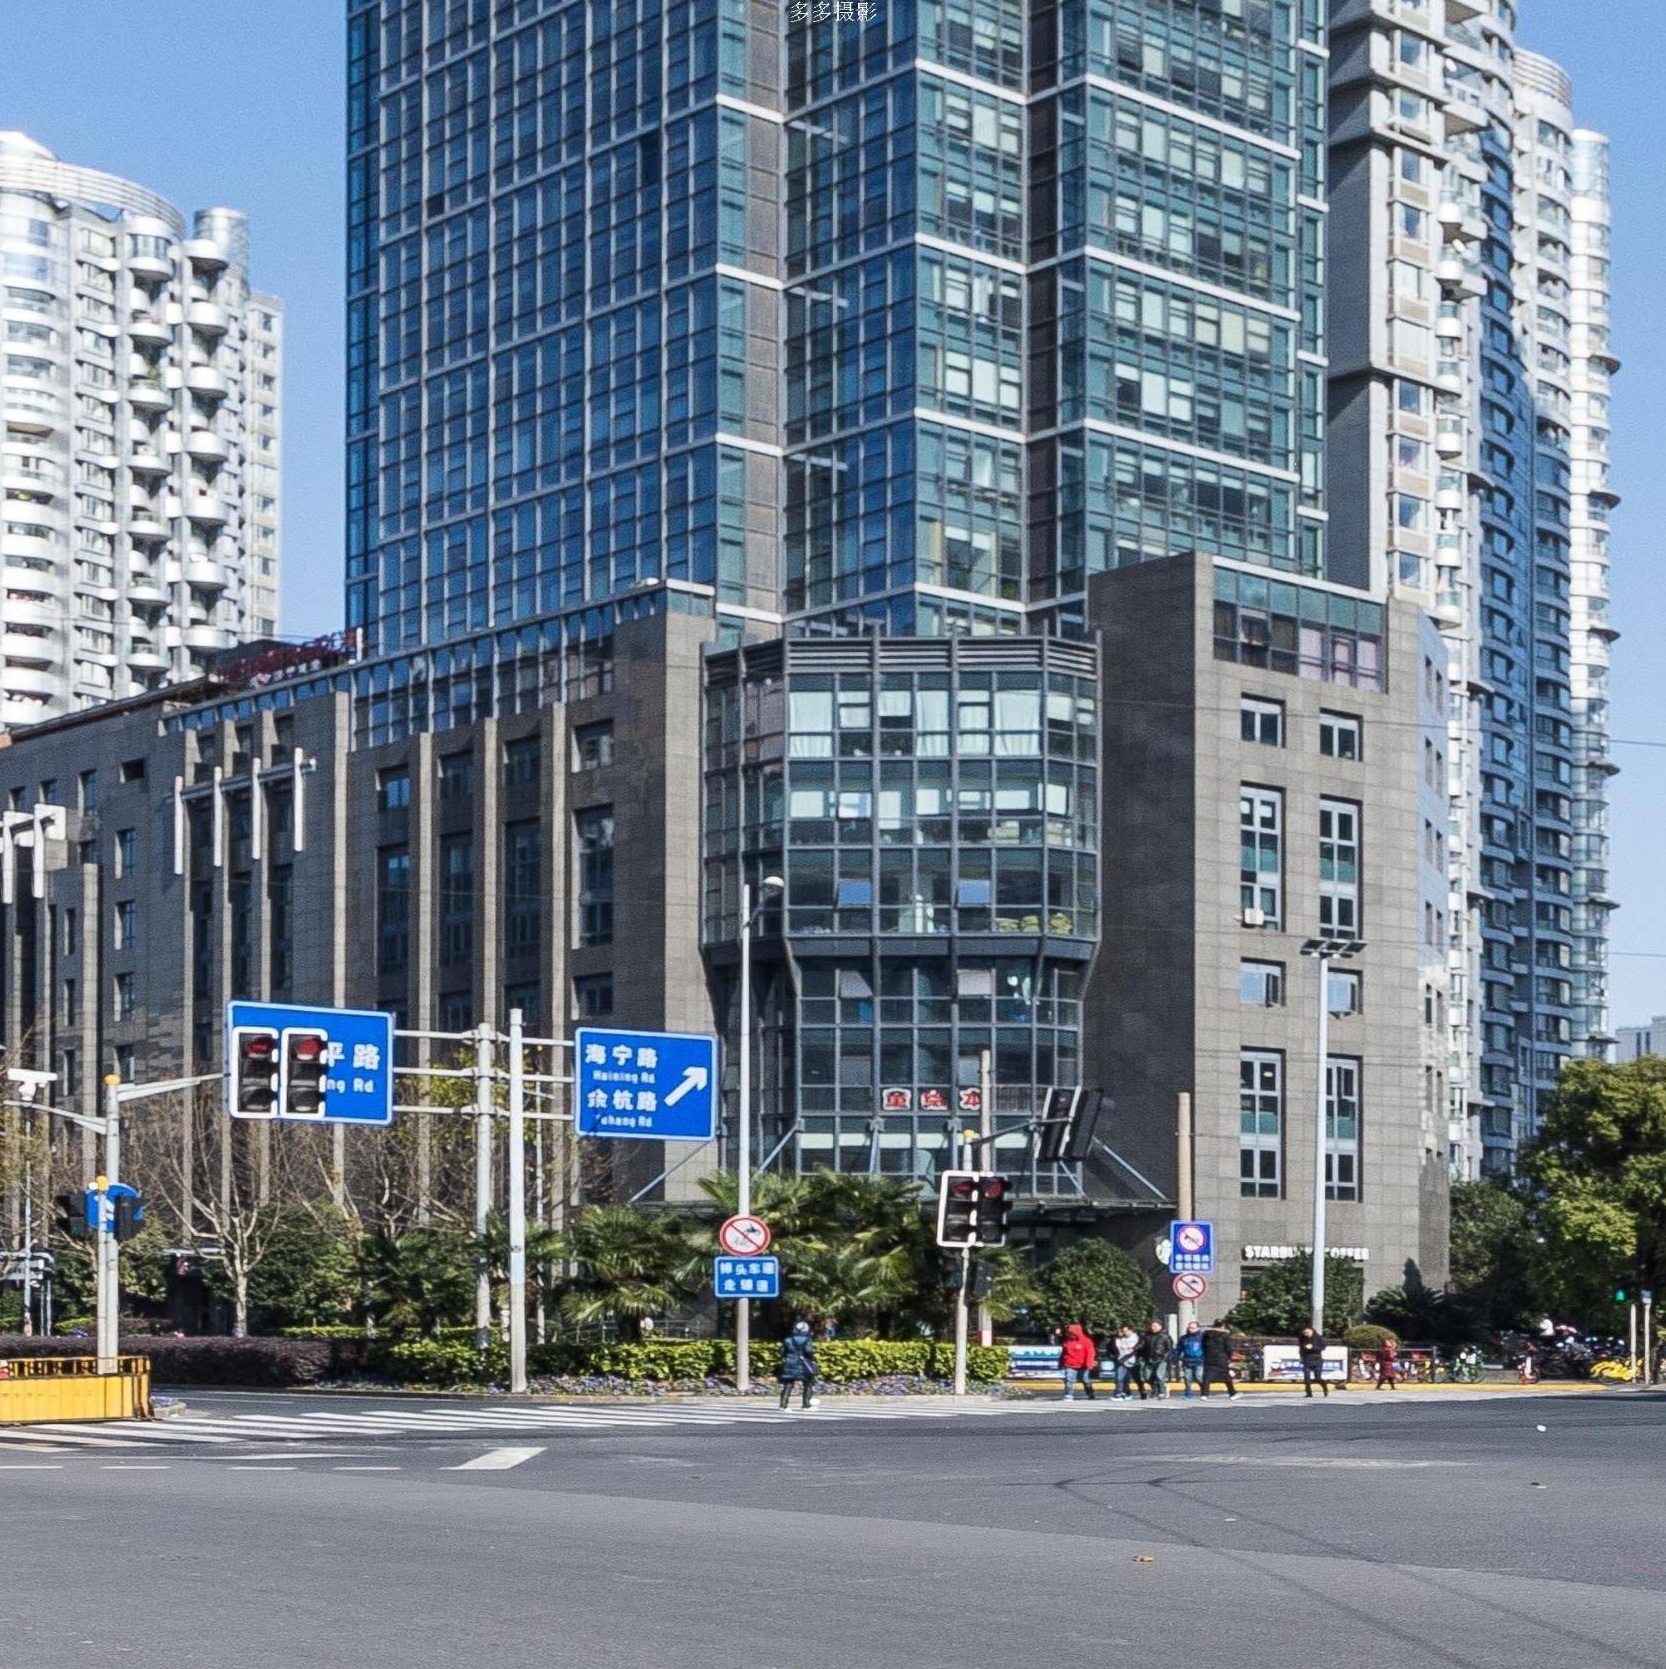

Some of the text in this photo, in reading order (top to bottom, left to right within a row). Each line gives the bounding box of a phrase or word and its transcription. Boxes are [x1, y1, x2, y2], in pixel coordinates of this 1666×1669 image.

[585, 1043, 658, 1069] 海宁路
[353, 1077, 374, 1092] Rd
[640, 1071, 655, 1084] Rd
[587, 1088, 657, 1112] 余杭路
[638, 1115, 652, 1128] Rd
